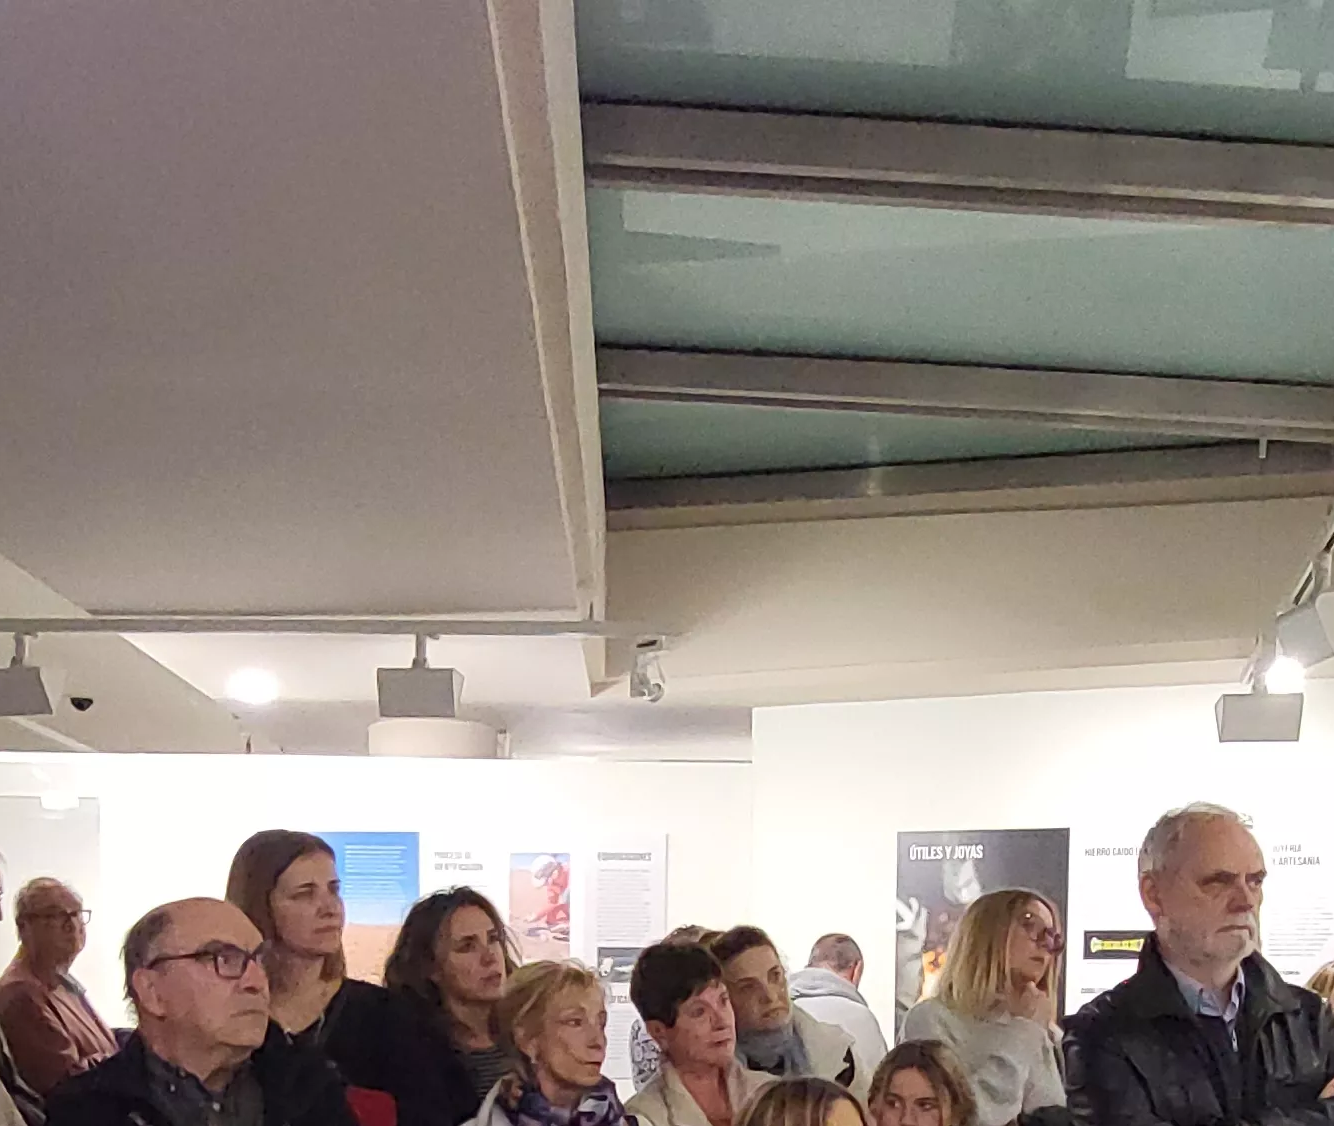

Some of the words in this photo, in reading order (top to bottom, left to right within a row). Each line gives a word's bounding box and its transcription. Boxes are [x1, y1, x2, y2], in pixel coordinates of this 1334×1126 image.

[909, 844, 944, 861] ÚTILES
[945, 845, 952, 860] Y
[953, 844, 984, 860] JOYAS
